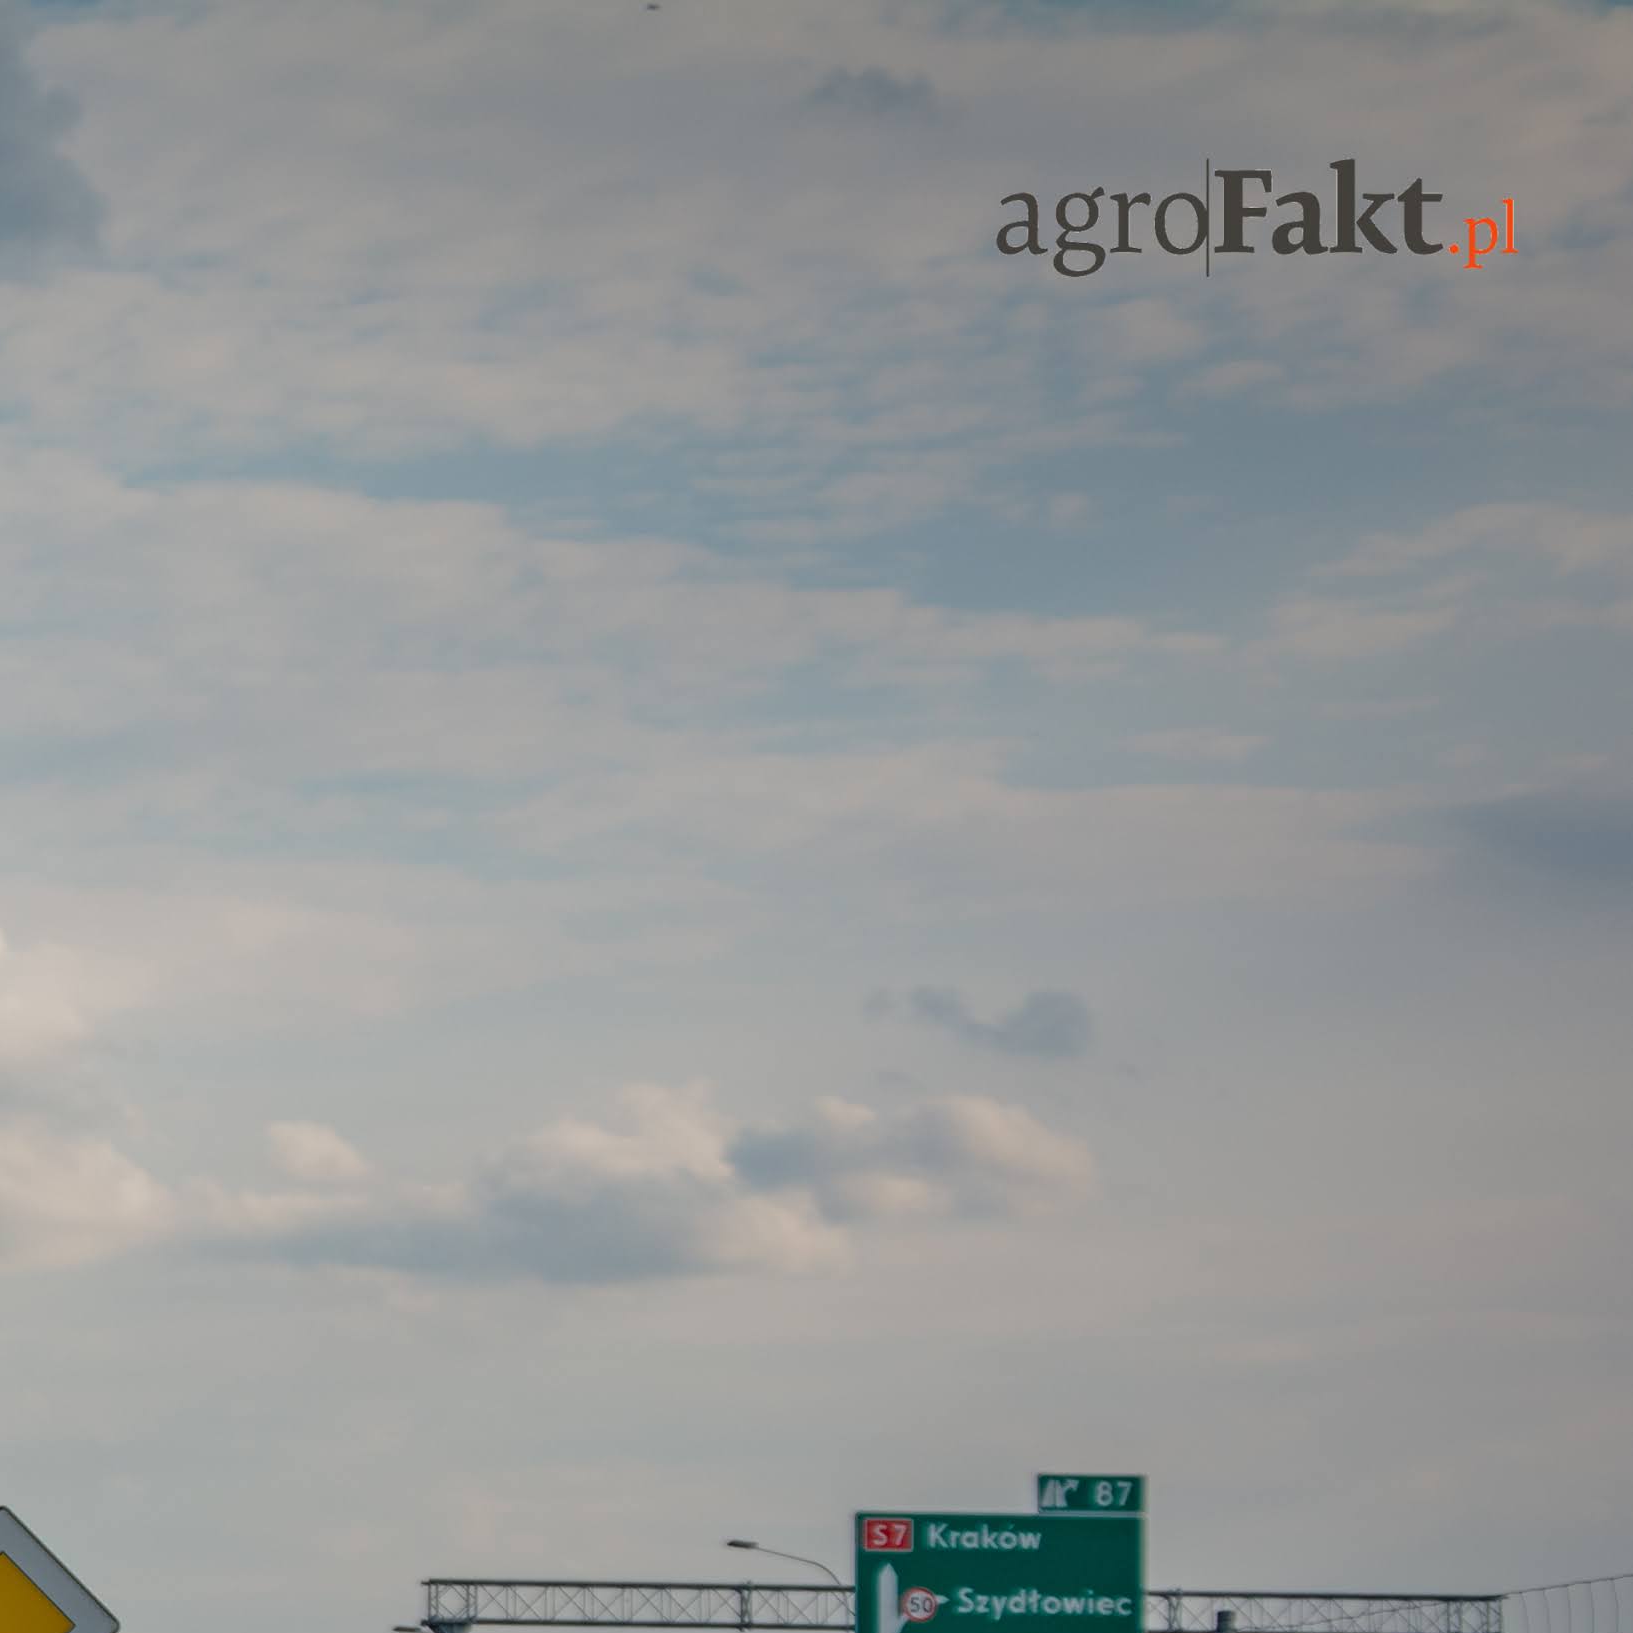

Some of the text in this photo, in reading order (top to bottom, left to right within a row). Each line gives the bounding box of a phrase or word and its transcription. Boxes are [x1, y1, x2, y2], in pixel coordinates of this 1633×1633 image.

[1095, 1480, 1133, 1507] 87
[871, 1522, 1042, 1551] S7 Kraków
[909, 1596, 933, 1615] 50
[956, 1587, 1133, 1621] Szydłowiec
